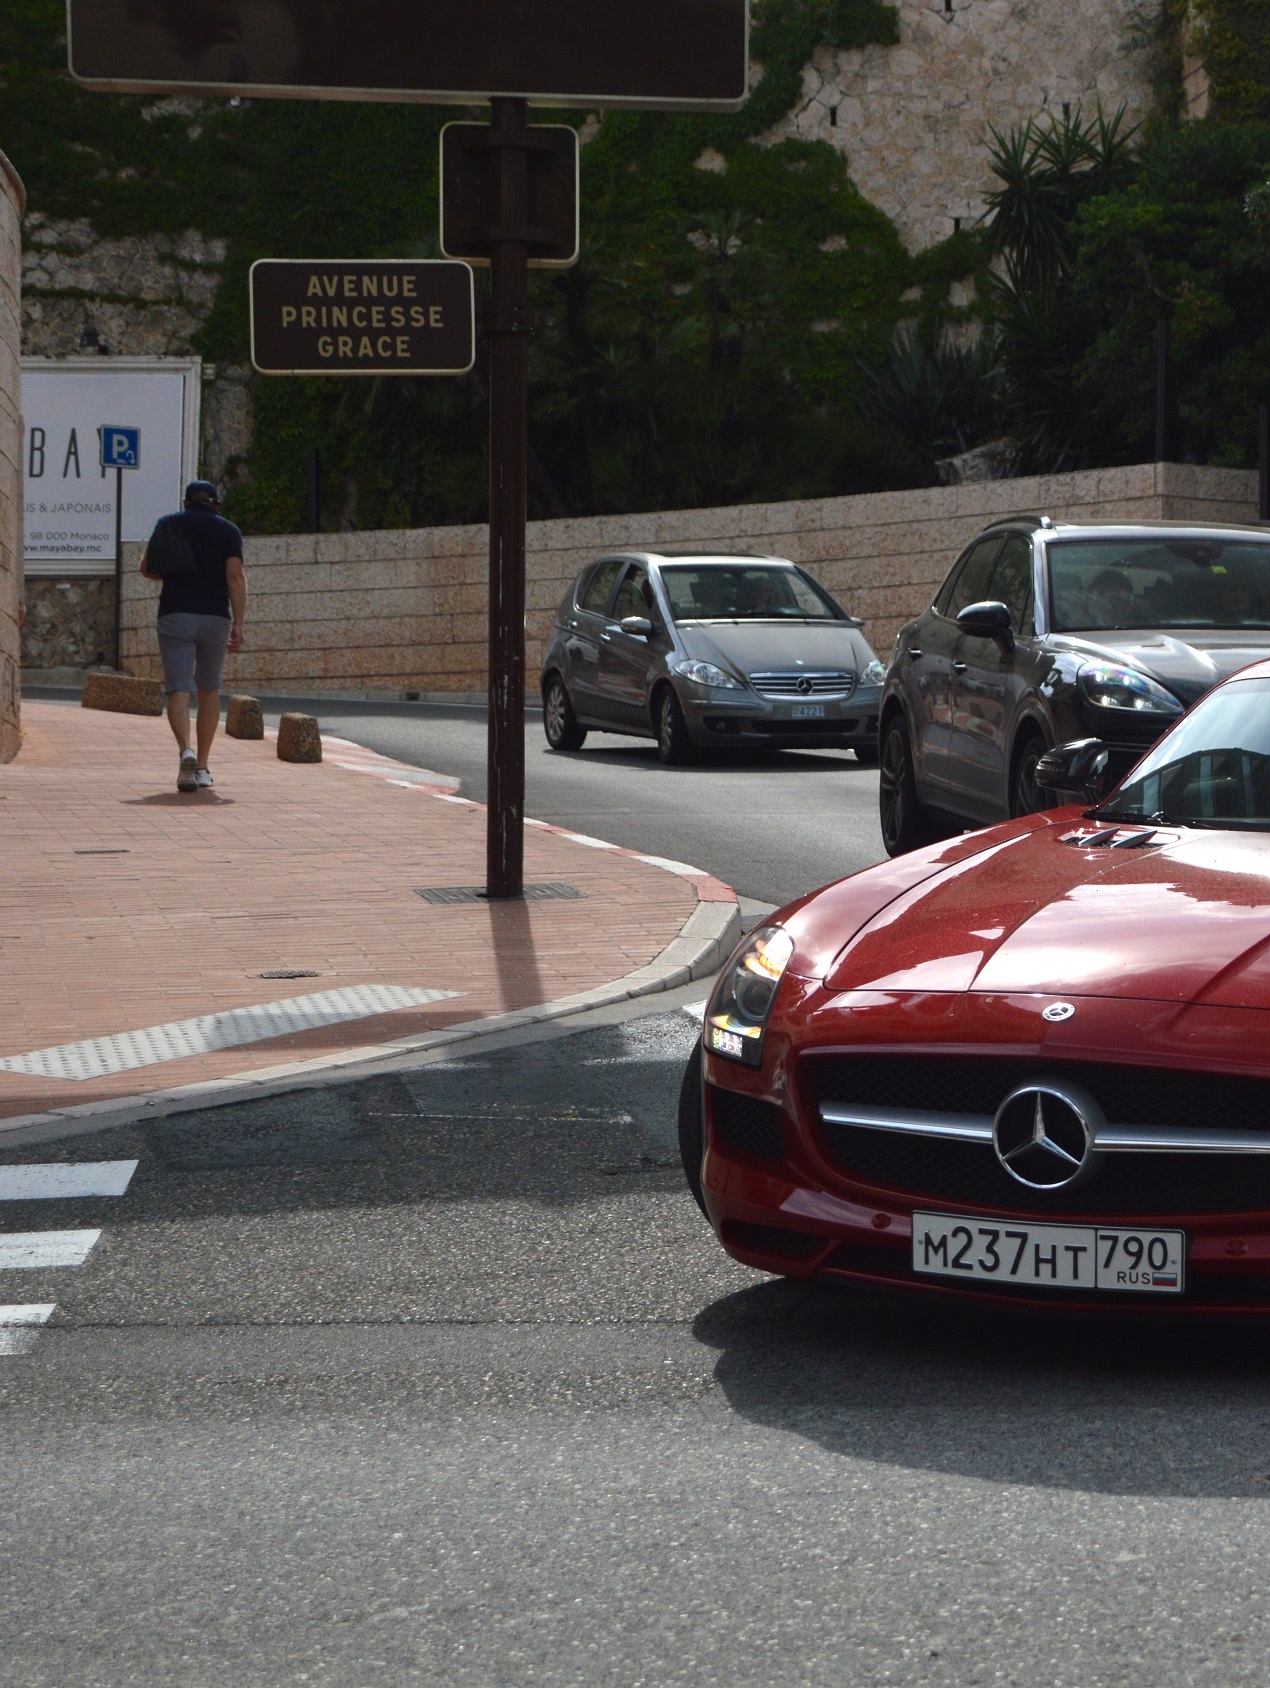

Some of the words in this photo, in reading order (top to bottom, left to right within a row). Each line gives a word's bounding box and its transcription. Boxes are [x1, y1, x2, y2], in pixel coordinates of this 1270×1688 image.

[307, 275, 418, 297] AVENUE
[281, 306, 444, 328] PRINCESSE
[317, 336, 411, 358] GRACE
[39, 503, 47, 513] &
[51, 503, 112, 513] JAPONAIS
[30, 531, 43, 540] 98
[46, 531, 68, 540] 000
[71, 532, 110, 541] Monaco
[800, 705, 823, 716] 4221
[1099, 1235, 1168, 1270] 790
[1117, 1271, 1150, 1285] RUS
